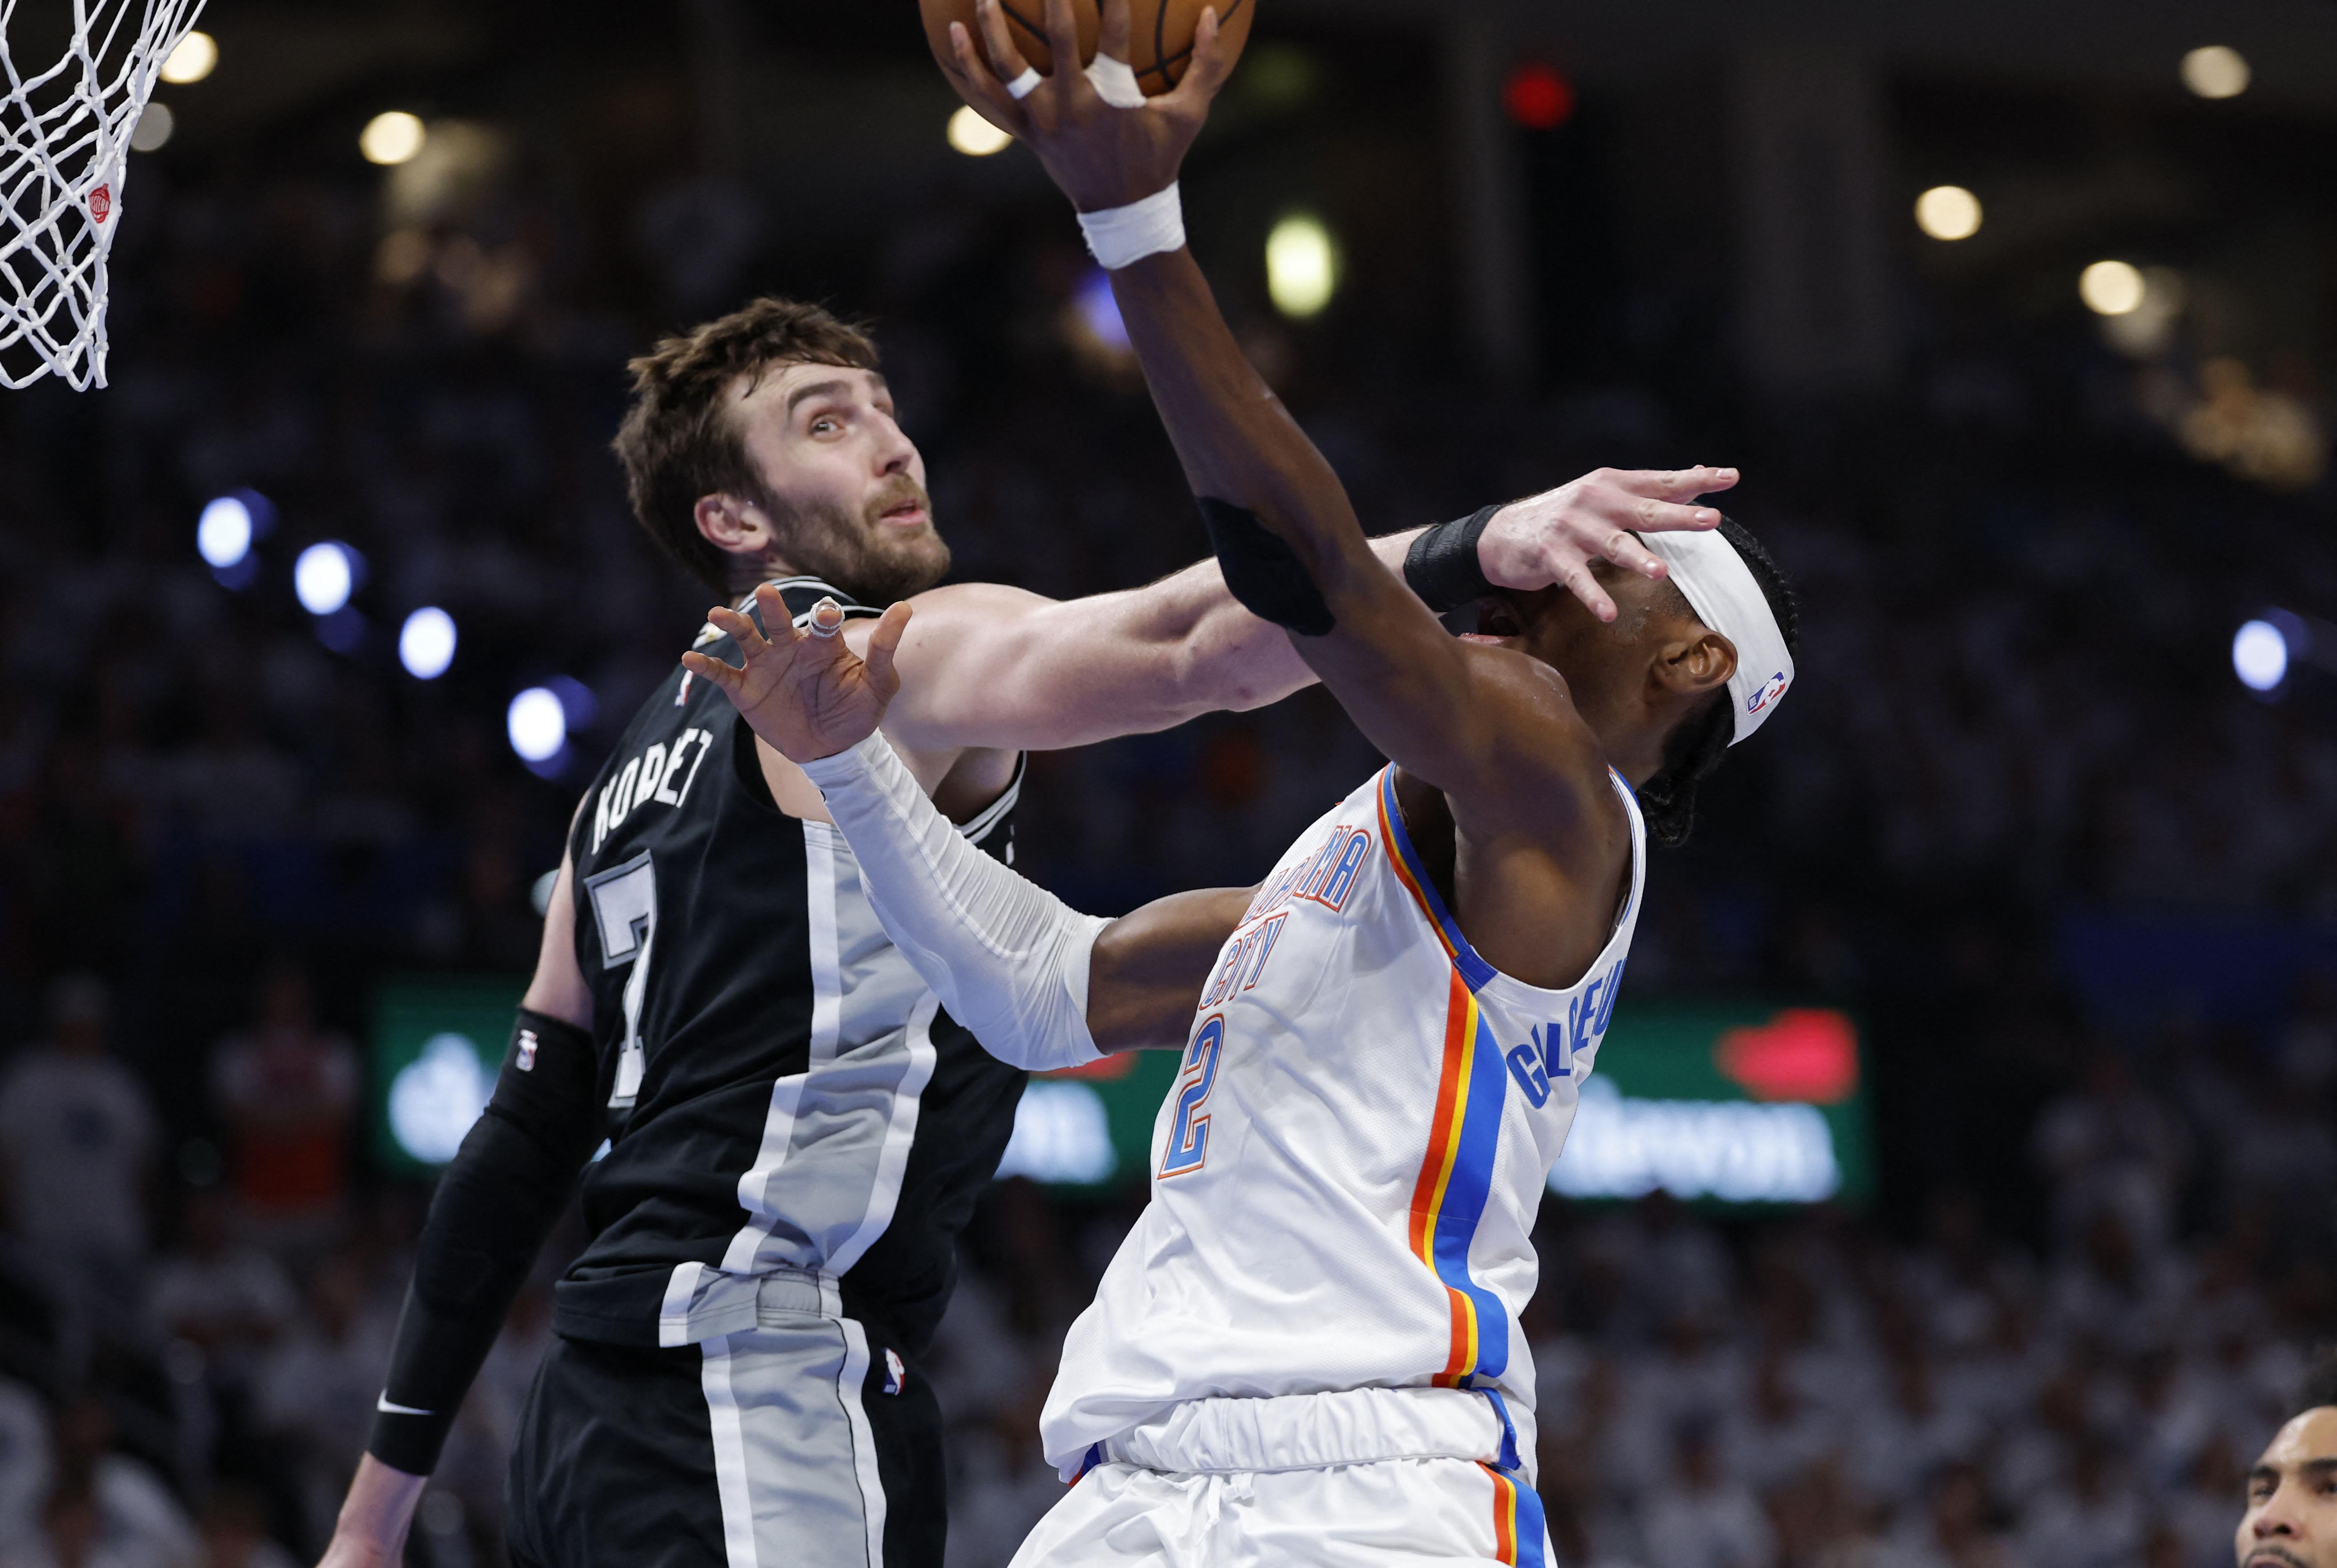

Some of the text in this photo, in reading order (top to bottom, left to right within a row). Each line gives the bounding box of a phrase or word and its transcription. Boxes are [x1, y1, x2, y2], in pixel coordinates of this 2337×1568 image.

[584, 848, 657, 1108] 7
[1199, 911, 1289, 1010] CITY
[1157, 1013, 1225, 1180] 2
